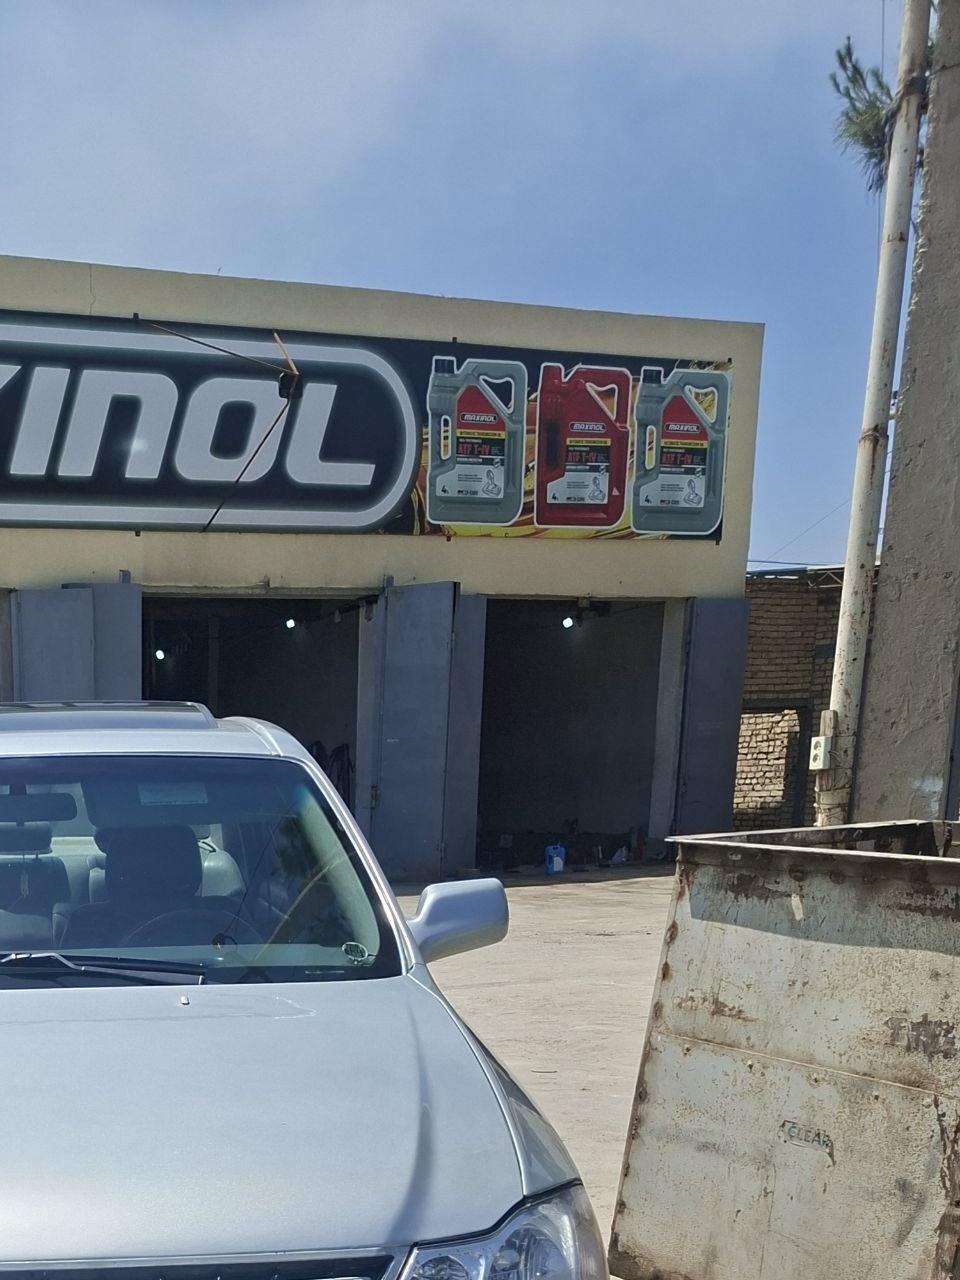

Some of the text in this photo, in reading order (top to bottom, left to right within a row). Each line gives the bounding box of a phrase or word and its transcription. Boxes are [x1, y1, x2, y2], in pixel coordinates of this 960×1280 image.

[464, 414, 496, 422] MAXINOL
[573, 423, 605, 431] MAXINOL
[668, 424, 700, 432] MAXINOL
